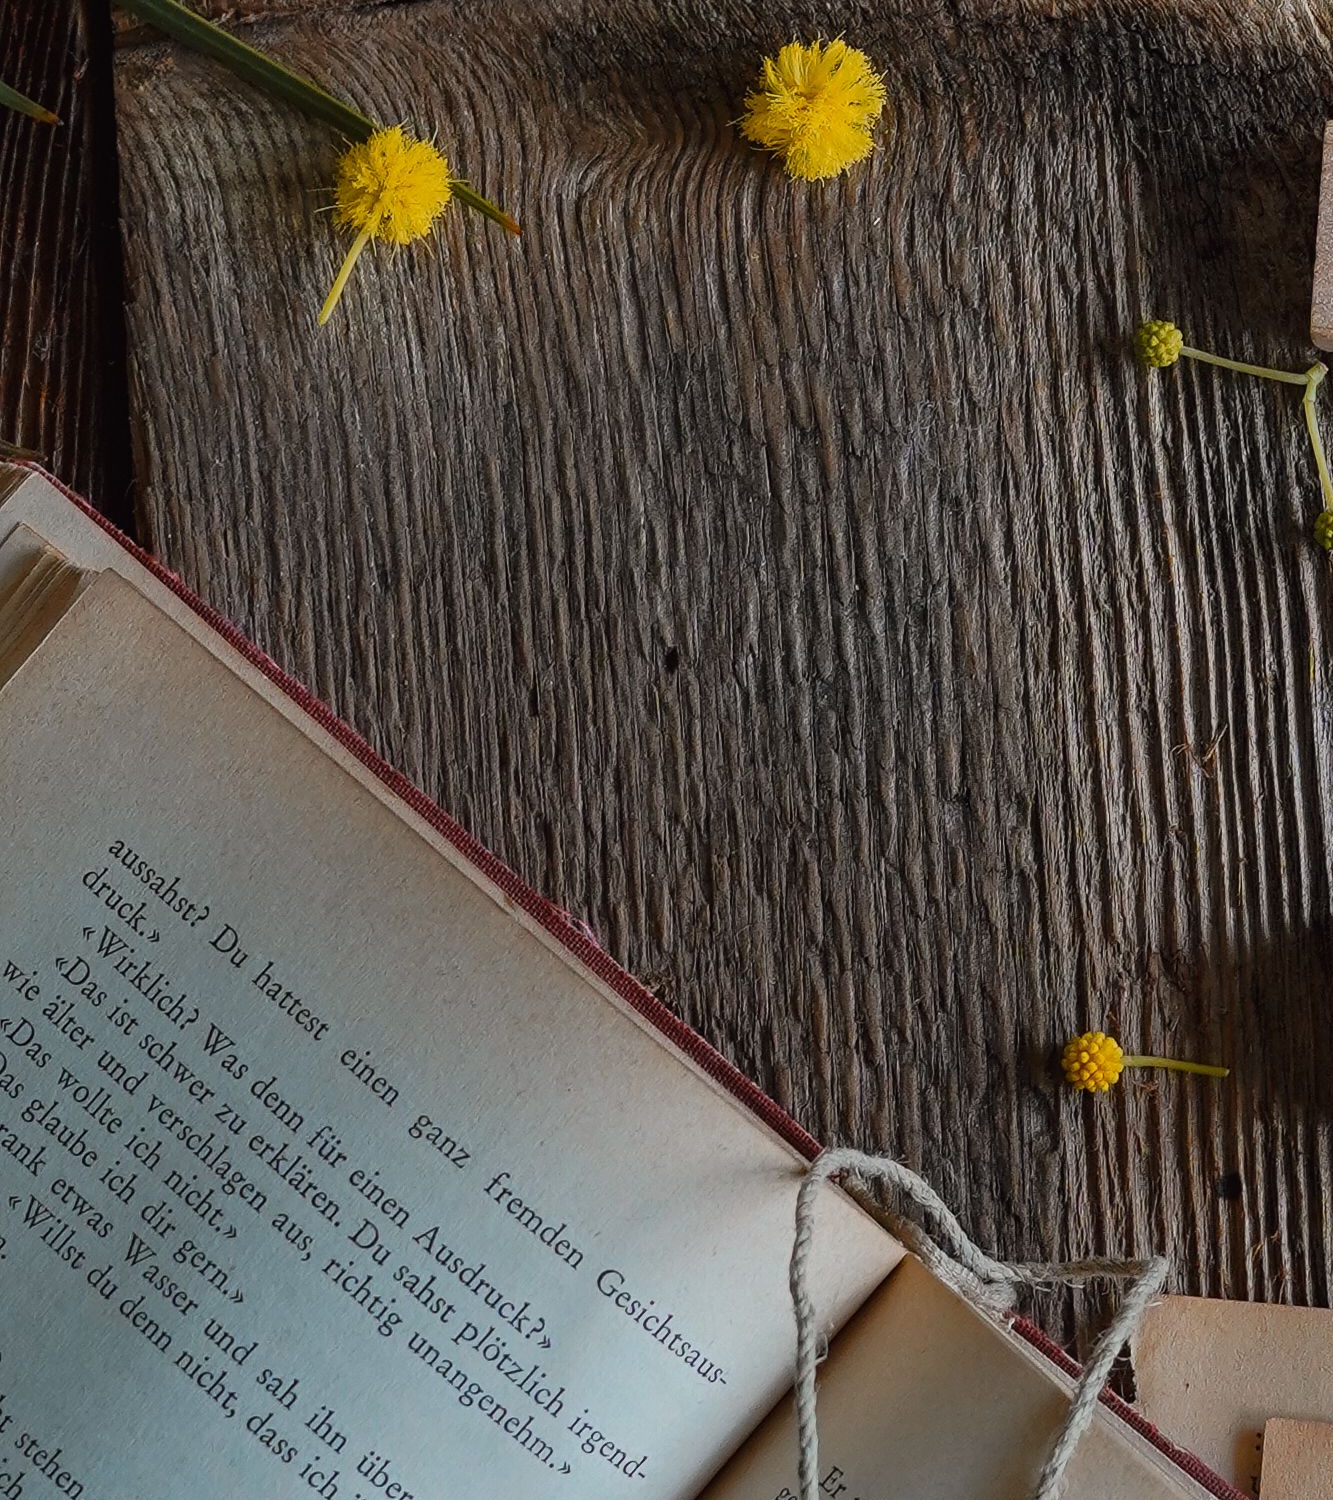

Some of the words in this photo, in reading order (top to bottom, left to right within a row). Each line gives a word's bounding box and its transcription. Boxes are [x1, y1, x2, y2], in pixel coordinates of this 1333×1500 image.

[107, 838, 211, 928] aussahst?
[207, 922, 250, 970] Du
[251, 959, 331, 1043] hattest
[339, 1049, 401, 1109] einen
[406, 1114, 472, 1170] ganz
[482, 1171, 585, 1272] fremden
[595, 1268, 728, 1386] Gesichtsaus-
[172, 1350, 239, 1419] nicht,
[245, 1411, 299, 1465] dass
